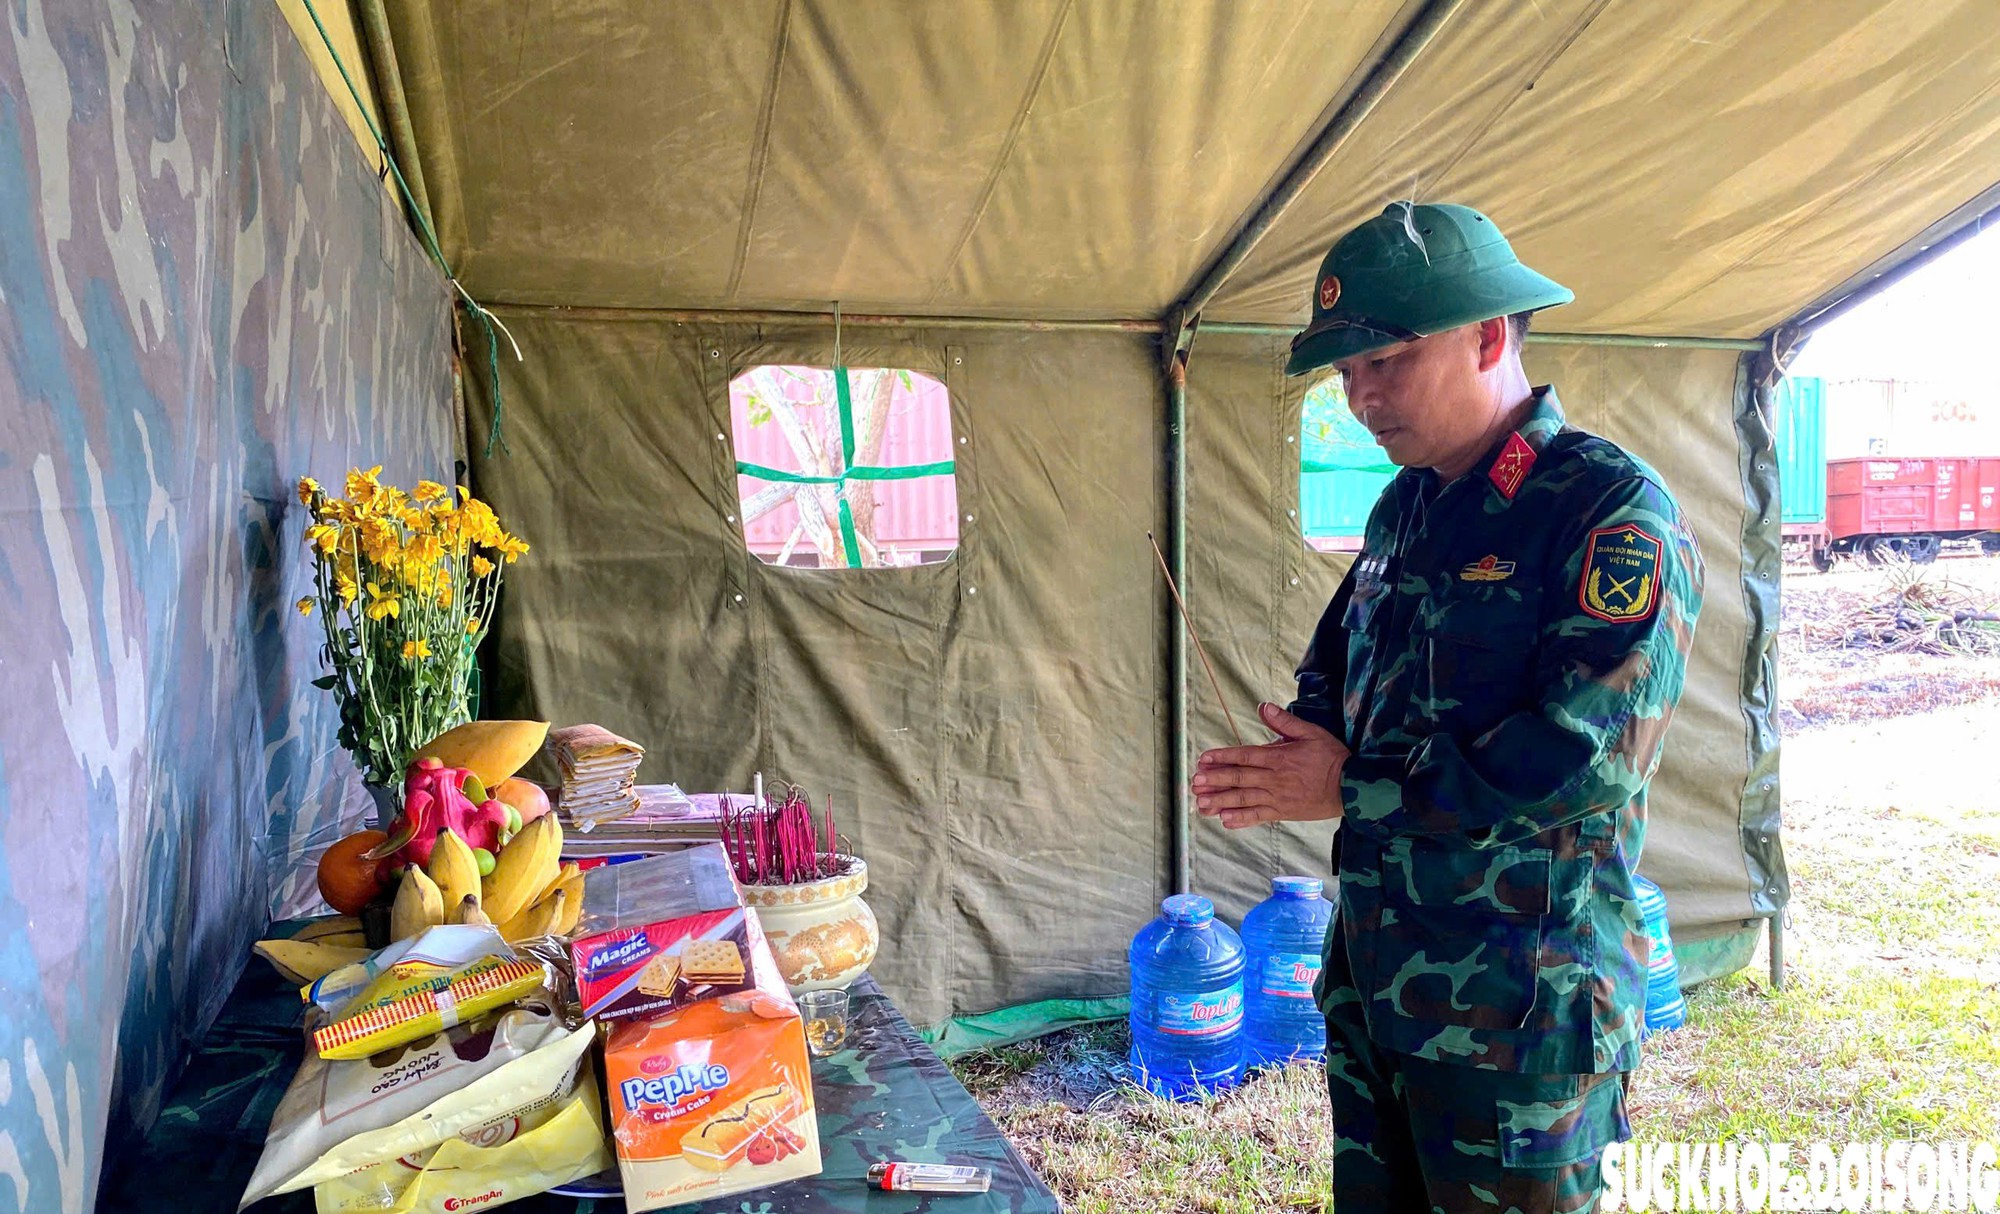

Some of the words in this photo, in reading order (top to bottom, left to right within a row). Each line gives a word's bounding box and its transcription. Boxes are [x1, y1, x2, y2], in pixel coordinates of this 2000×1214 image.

[1609, 556, 1625, 565] VIỆT
[1625, 558, 1641, 567] NAM
[591, 936, 647, 970] Magic
[621, 947, 651, 965] CREAMS
[653, 1106, 686, 1120] Cream
[686, 1095, 711, 1111] Cake
